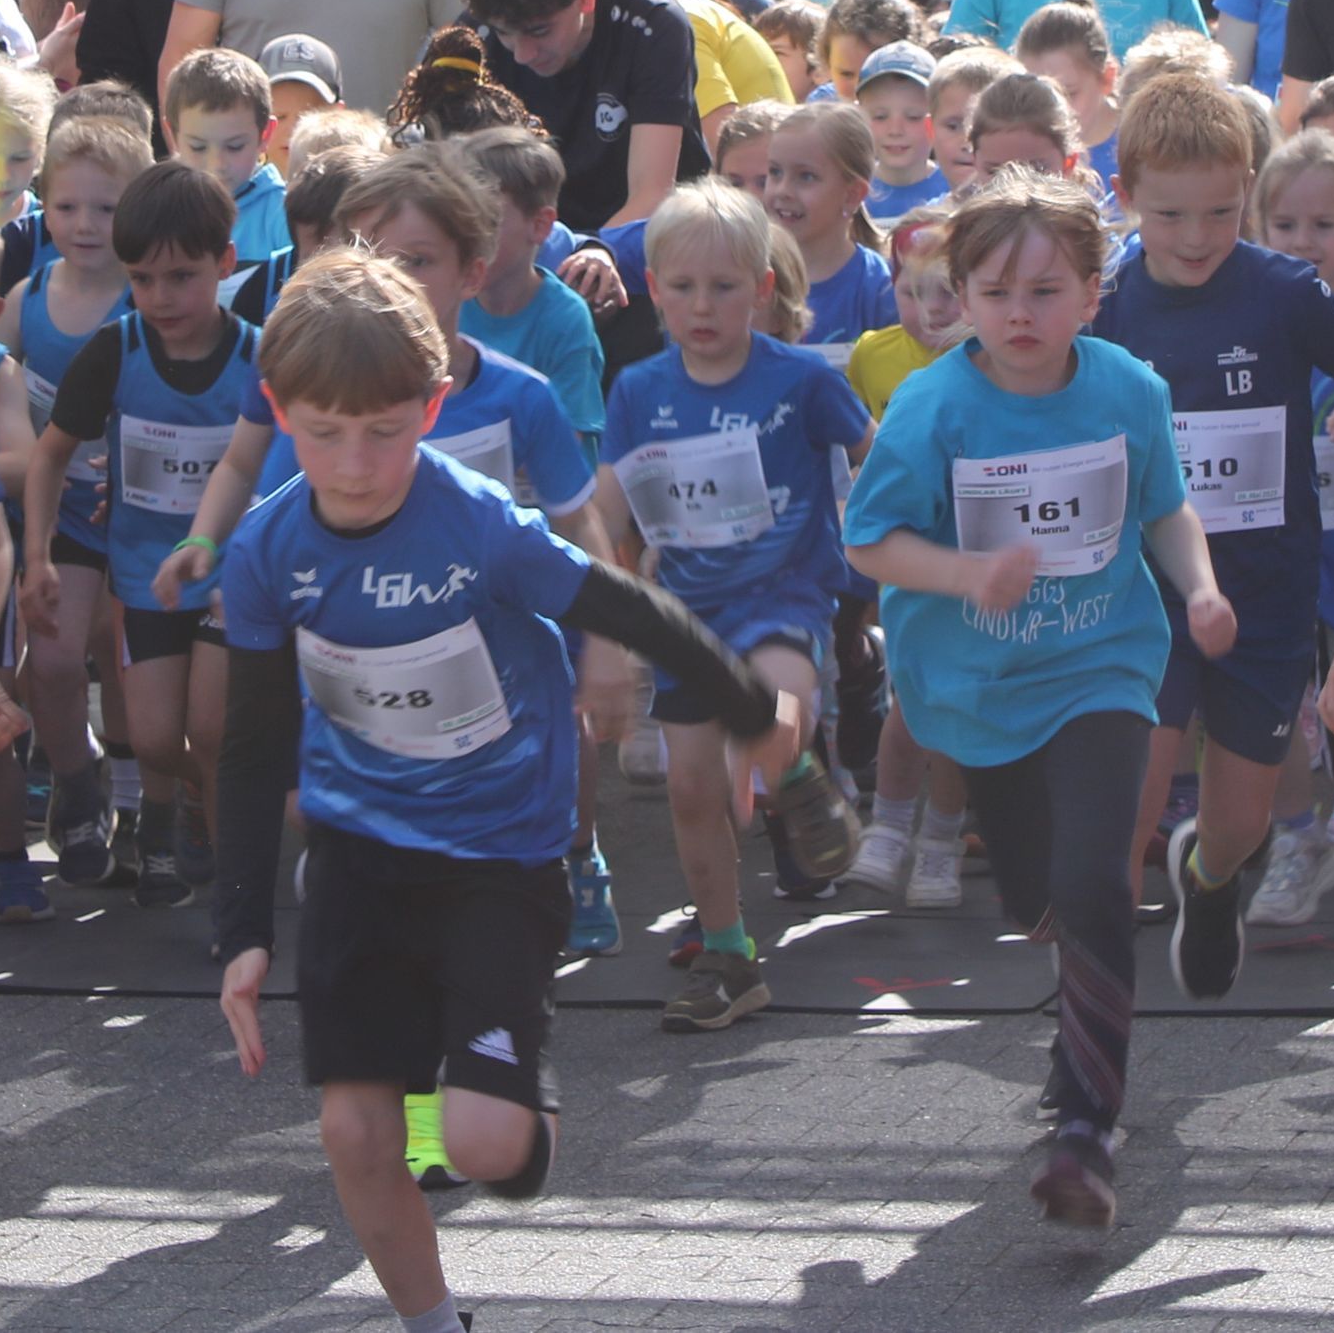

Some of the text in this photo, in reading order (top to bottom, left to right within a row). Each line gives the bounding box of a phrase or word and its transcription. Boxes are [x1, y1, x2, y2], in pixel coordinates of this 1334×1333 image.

[1225, 370, 1253, 396] LB
[996, 463, 1028, 477] ONI
[669, 479, 718, 500] 474
[1191, 483, 1223, 492] Lukas
[1013, 496, 1081, 523] 161
[1031, 525, 1070, 536] Hanna
[361, 565, 448, 609] LGW
[1026, 577, 1066, 605] GGS
[354, 688, 434, 709] 528
